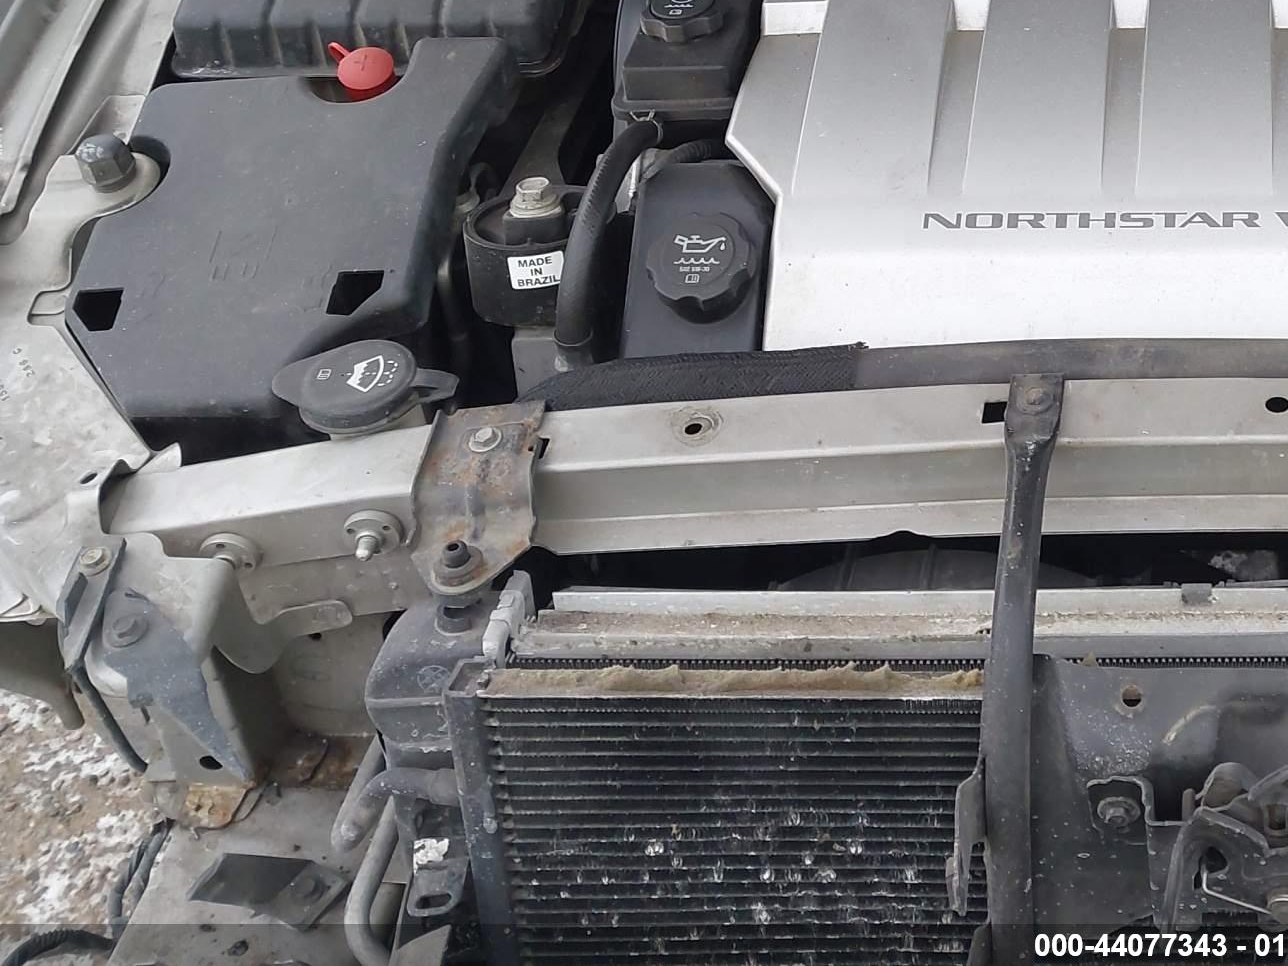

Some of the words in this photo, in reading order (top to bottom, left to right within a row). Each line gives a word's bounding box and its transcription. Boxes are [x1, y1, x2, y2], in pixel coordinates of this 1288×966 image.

[922, 211, 1262, 230] NORTHSTAR
[517, 255, 553, 268] MADE
[530, 267, 543, 276] IN
[517, 274, 561, 287] BRAZIL
